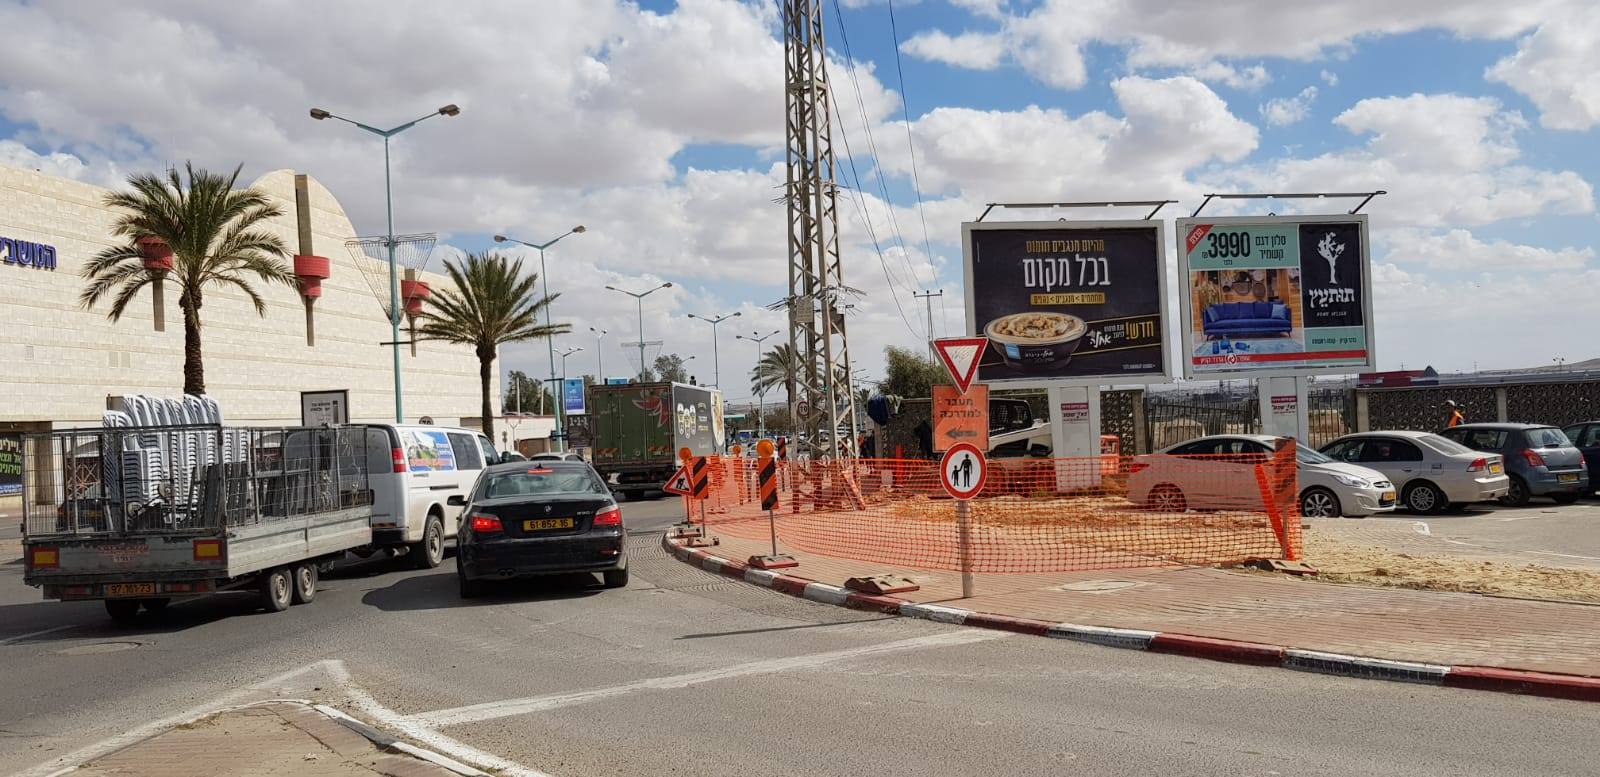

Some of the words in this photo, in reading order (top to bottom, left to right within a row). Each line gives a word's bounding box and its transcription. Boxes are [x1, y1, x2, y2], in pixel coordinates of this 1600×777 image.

[1053, 240, 1080, 253] מנגבים
[1081, 240, 1105, 252] מהיום
[1207, 232, 1251, 258] 3990
[1255, 236, 1269, 247] דגם
[1271, 235, 1287, 248] סלון
[1022, 257, 1071, 293] מקום
[1075, 253, 1111, 287] בכל
[1125, 320, 1154, 340] חדש!
